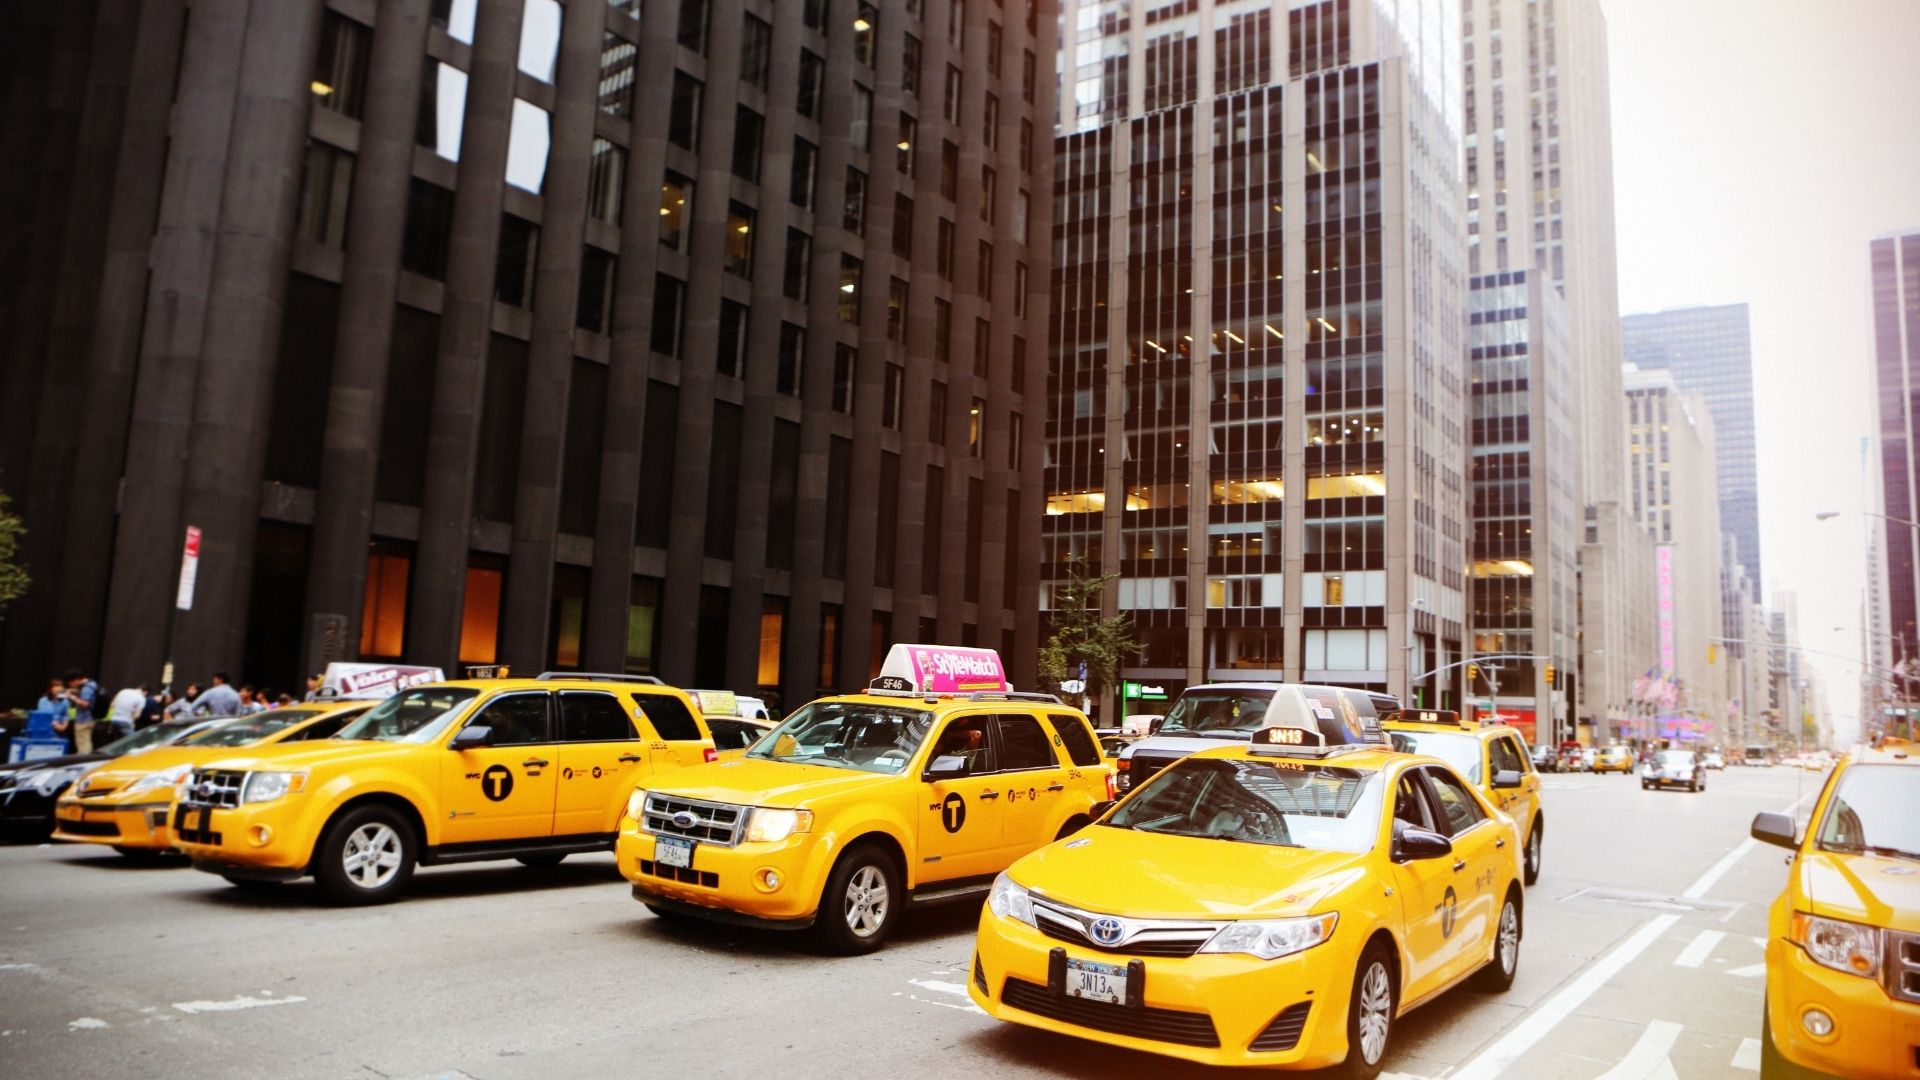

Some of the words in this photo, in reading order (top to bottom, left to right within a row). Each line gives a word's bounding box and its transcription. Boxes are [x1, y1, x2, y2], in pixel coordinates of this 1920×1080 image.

[933, 653, 999, 680] StyleWatch
[883, 678, 903, 690] 5F46
[1269, 728, 1303, 744] 3N13
[929, 802, 942, 811] NYC
